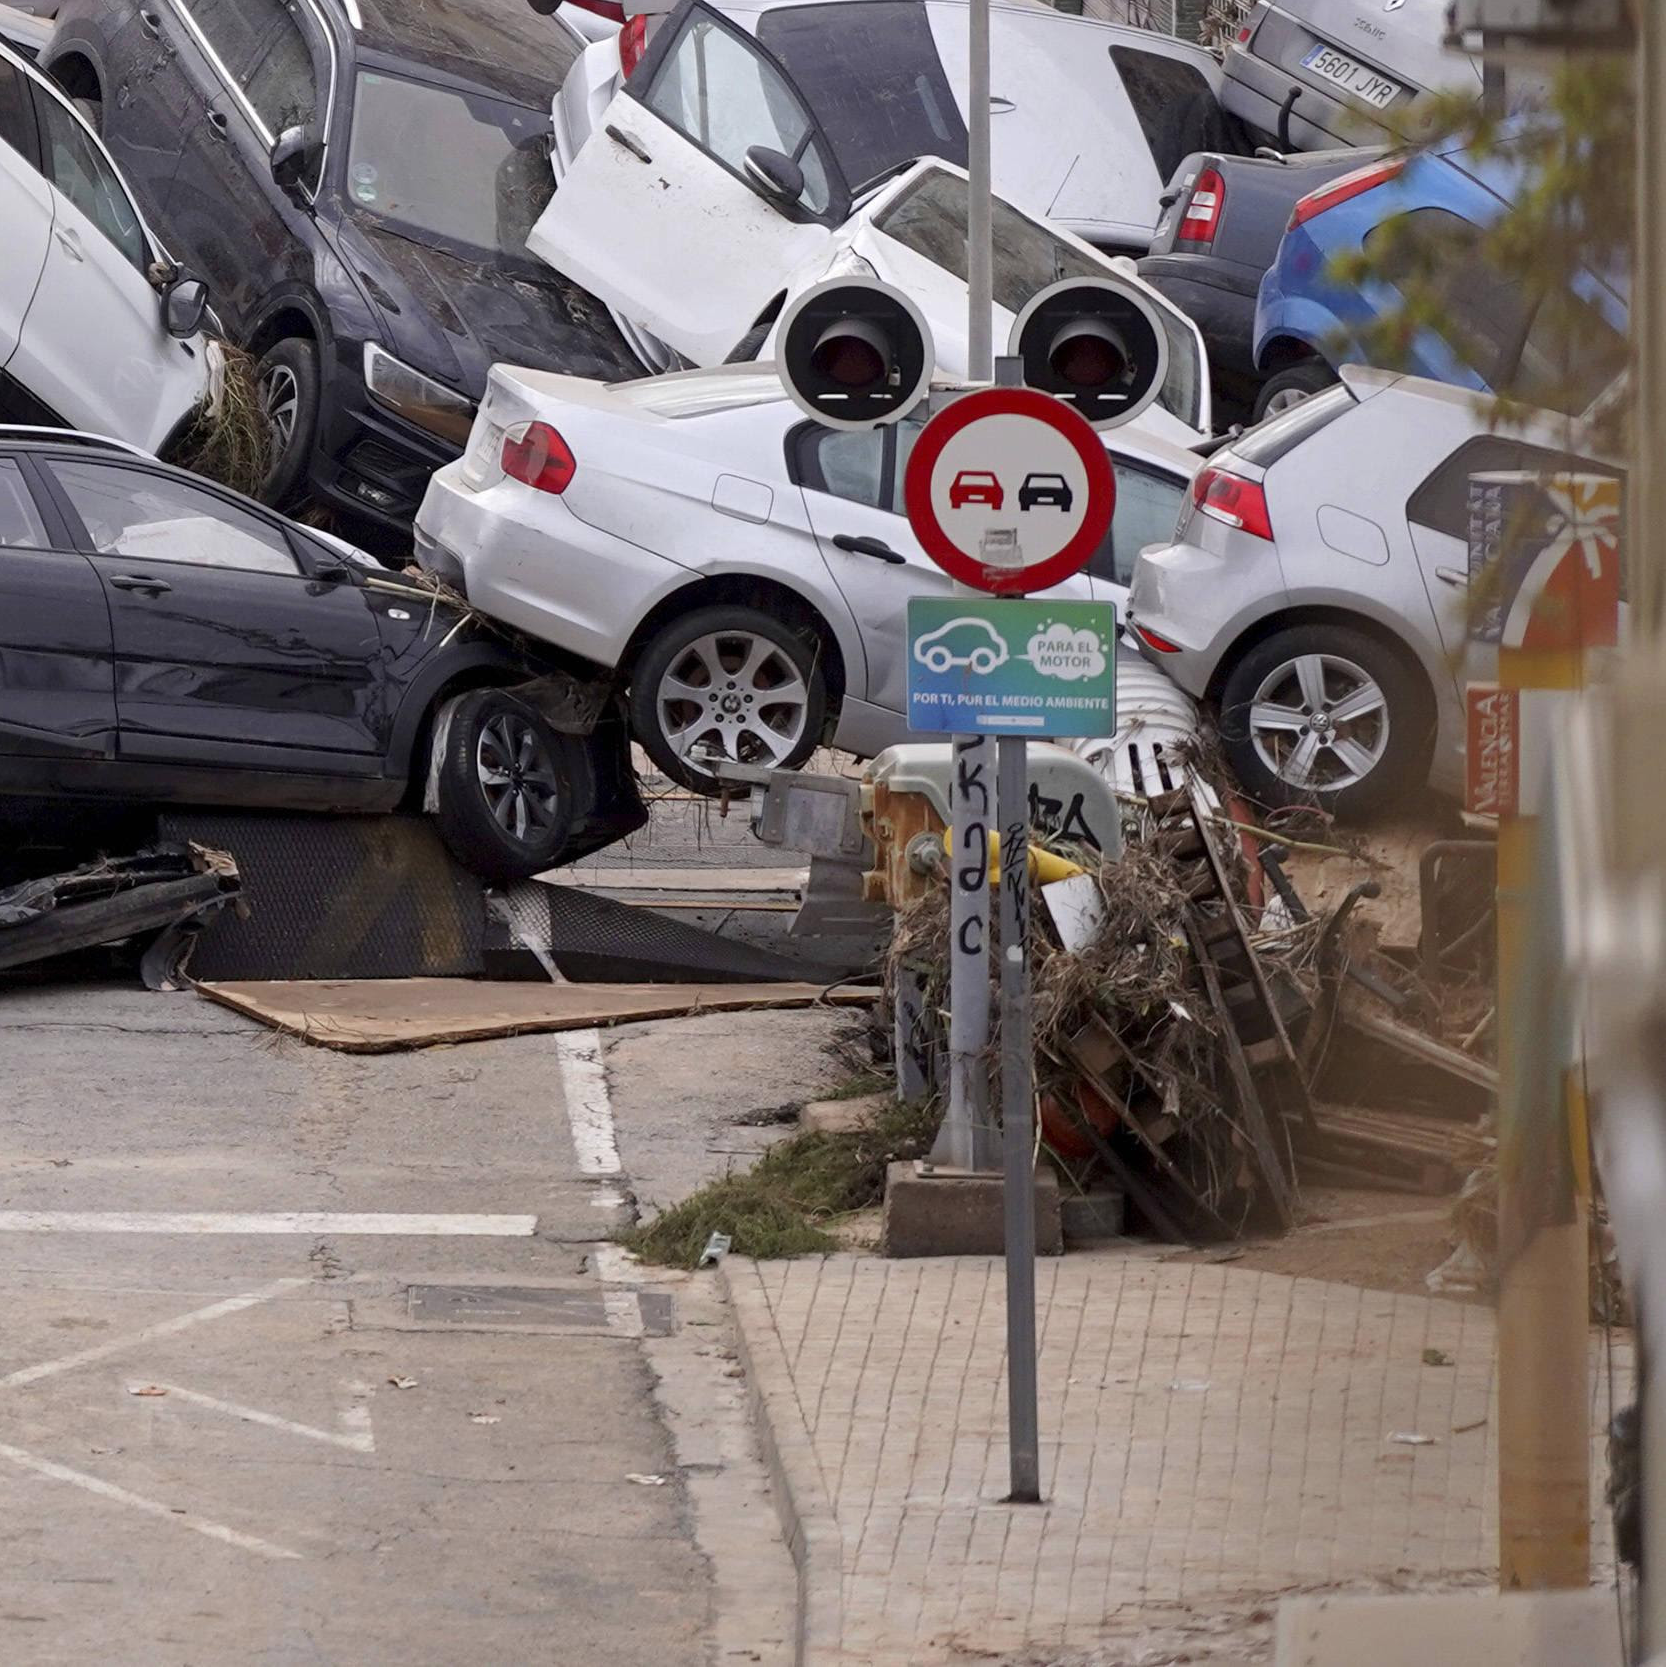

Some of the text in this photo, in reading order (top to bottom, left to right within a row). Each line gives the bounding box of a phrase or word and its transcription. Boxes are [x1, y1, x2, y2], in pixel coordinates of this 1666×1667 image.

[1314, 51, 1393, 104] 5601 JYR
[1037, 640, 1093, 653] PARA EL
[1040, 655, 1091, 667] MOTOR
[913, 693, 1108, 709] POR TI, POR EL MEDIO AMBIENTE
